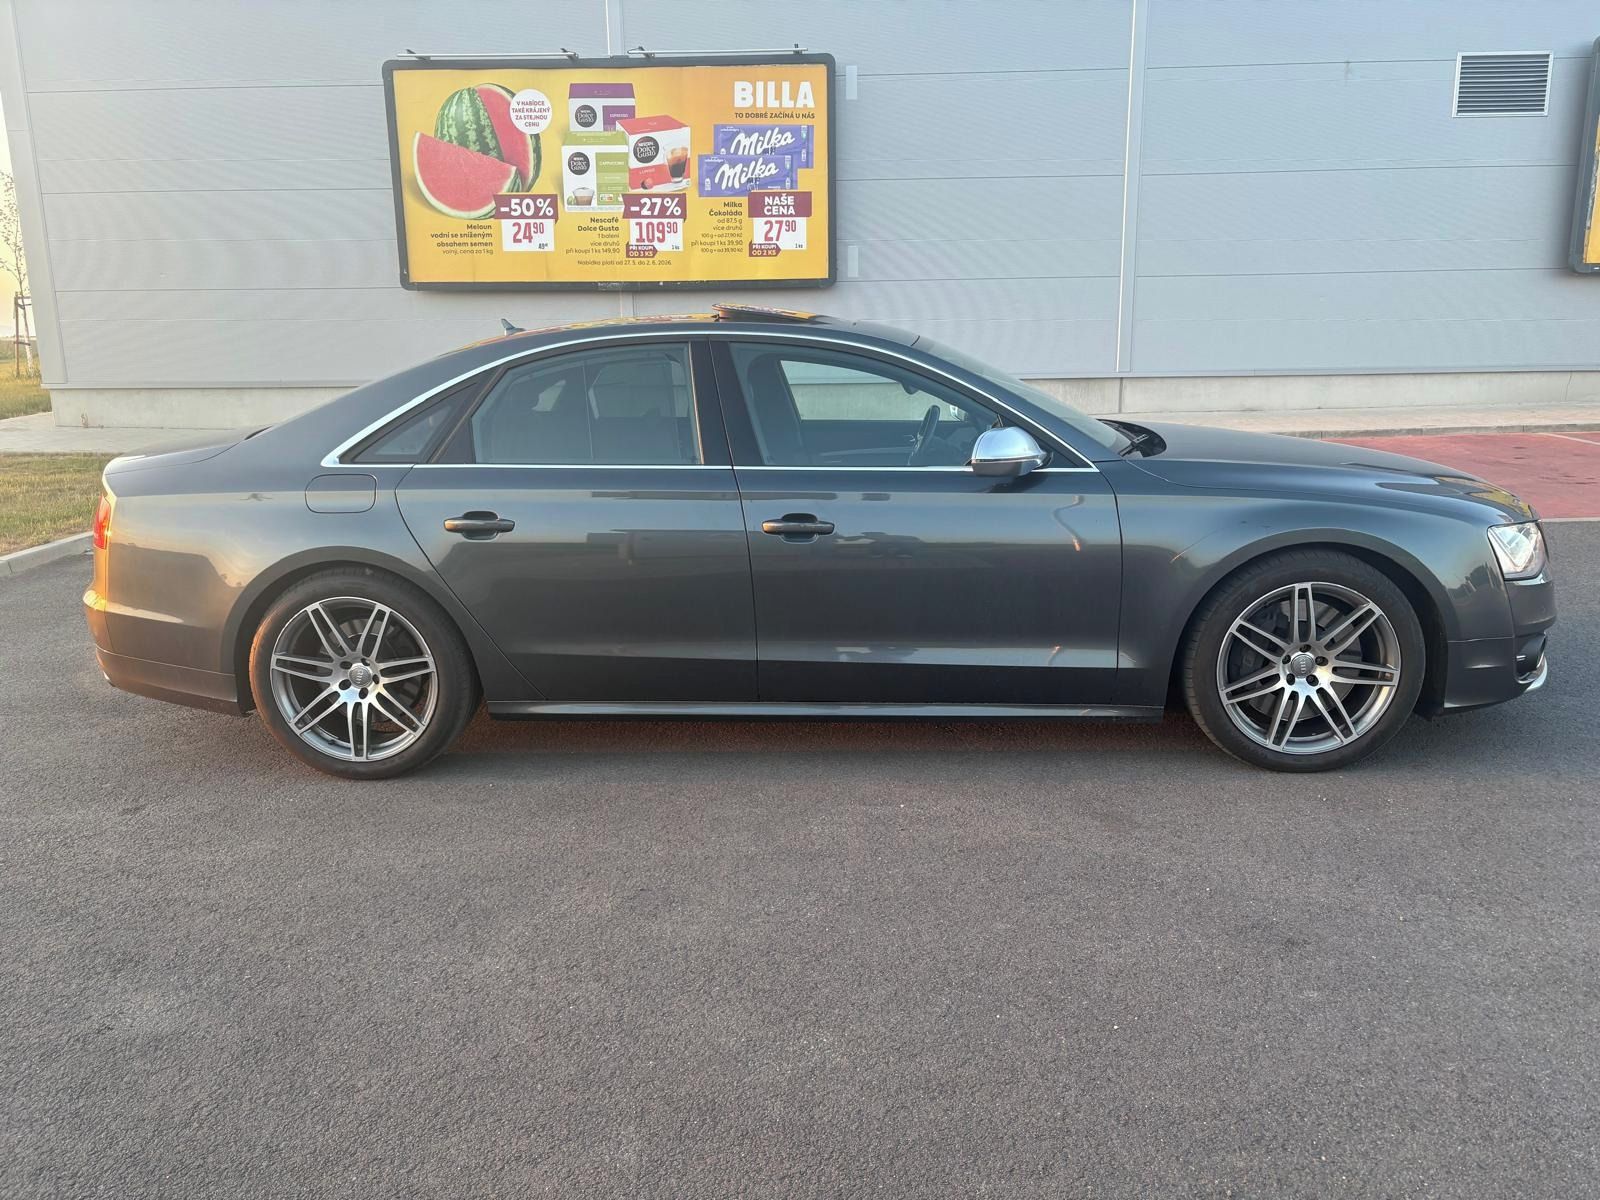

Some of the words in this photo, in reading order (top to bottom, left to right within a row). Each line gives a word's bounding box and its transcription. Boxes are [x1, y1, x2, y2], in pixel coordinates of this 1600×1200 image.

[734, 81, 815, 108] BILLA
[730, 127, 795, 155] Milka
[715, 158, 779, 190] Milka
[500, 198, 553, 217] -50%
[631, 198, 681, 216] -27%
[764, 193, 794, 205] NAŠE
[764, 206, 795, 215] CENA
